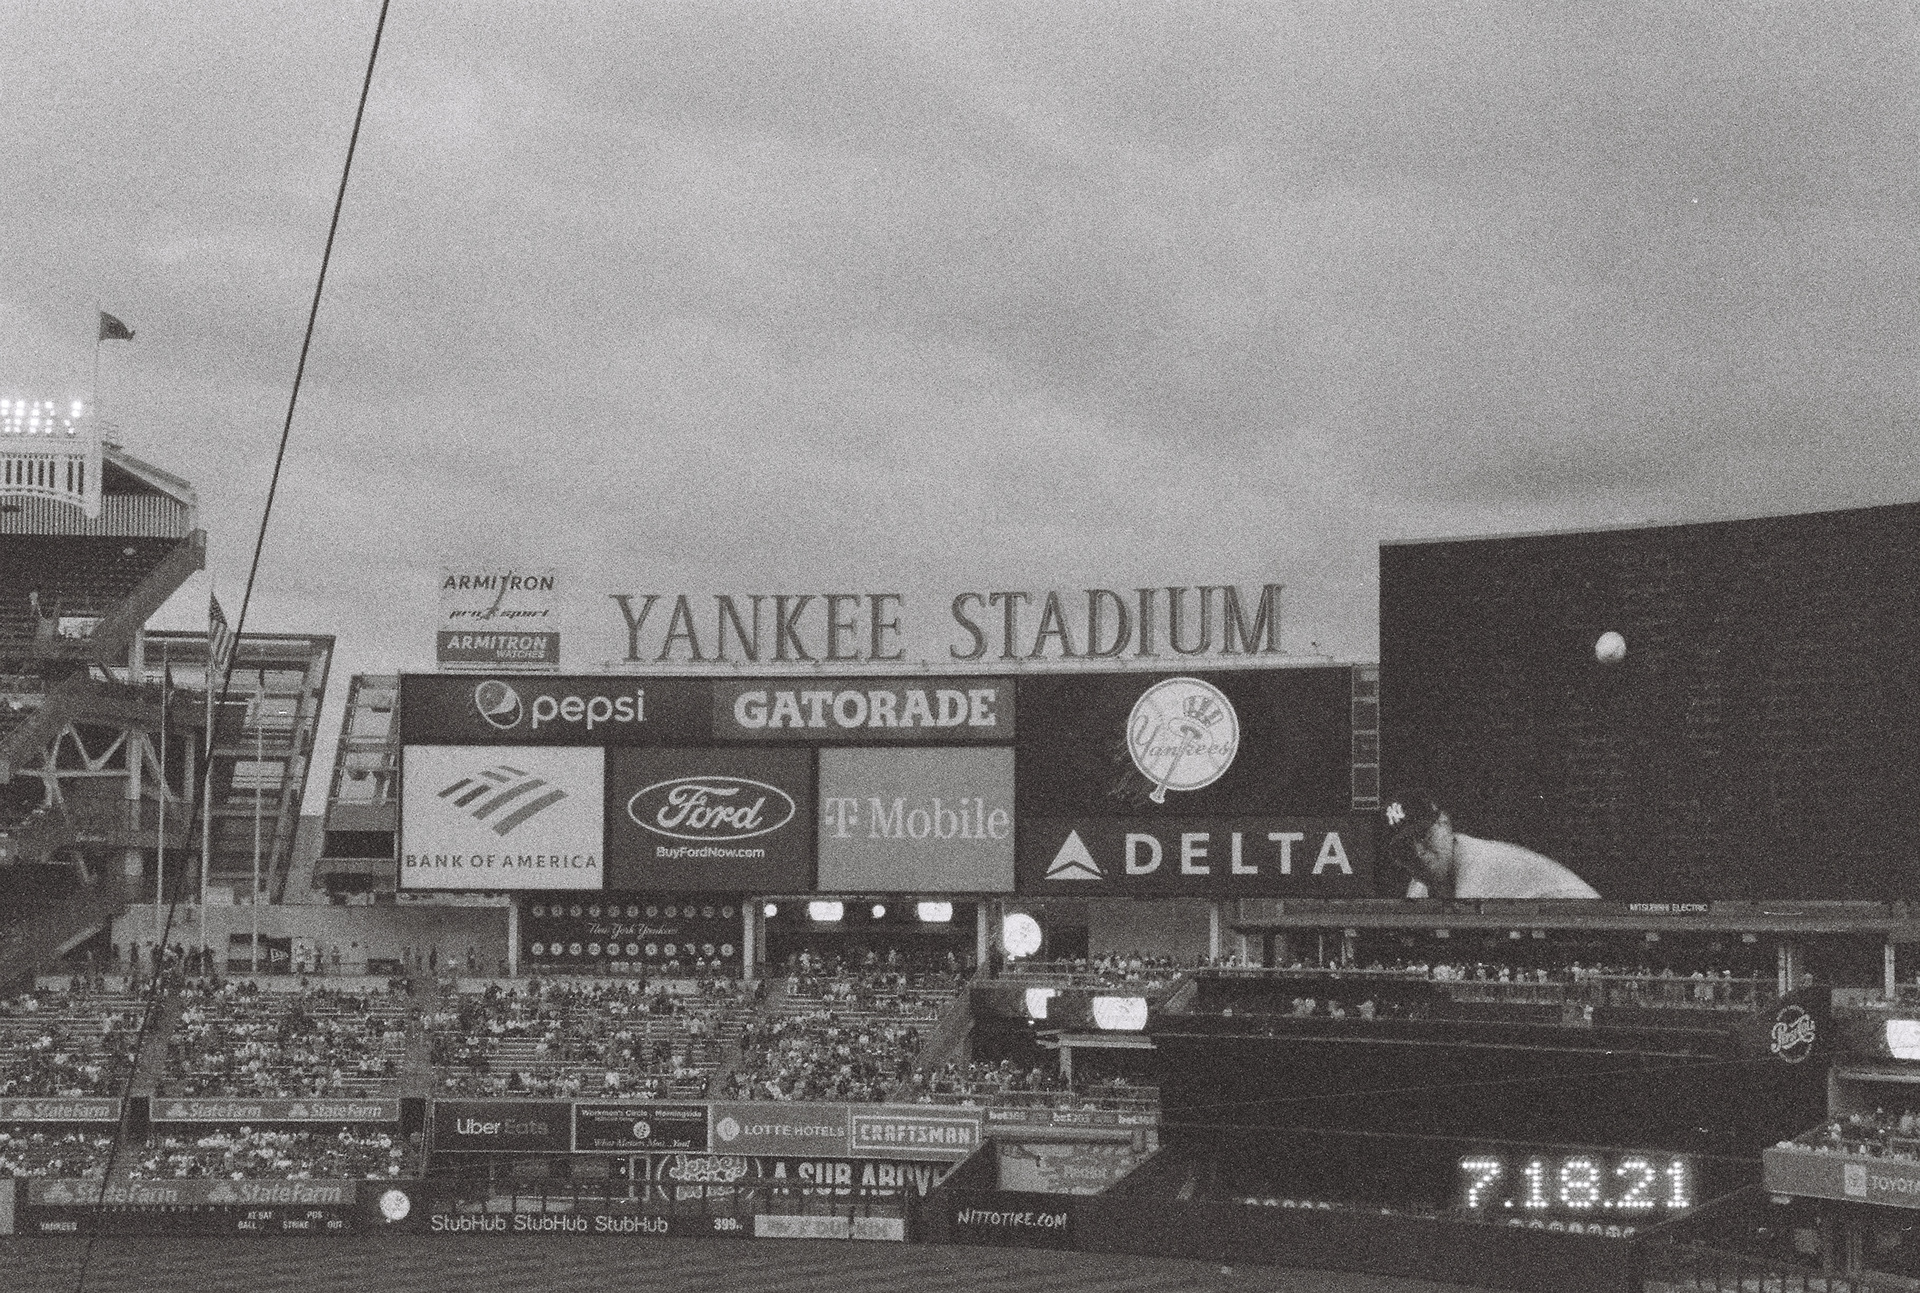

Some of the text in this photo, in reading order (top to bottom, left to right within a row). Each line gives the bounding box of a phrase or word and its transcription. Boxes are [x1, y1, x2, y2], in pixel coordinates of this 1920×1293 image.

[443, 574, 555, 590] ARMITRON
[609, 583, 1287, 665] YANKEE STADIUM
[447, 635, 547, 650] ARMITRON
[532, 689, 645, 729] pepsi
[733, 687, 998, 730] GATORADE
[657, 784, 764, 829] Ford
[867, 795, 1010, 841] Mobile
[405, 853, 598, 869] BANK OF AMERICA
[656, 846, 764, 859] BuyFordNow.com
[1124, 830, 1353, 874] DELTA
[457, 1118, 549, 1135] Uber Eats
[744, 1123, 846, 1138] LOTTE HOTELS
[860, 1124, 971, 1145] CRAFTSMAN
[773, 1162, 790, 1196] A
[798, 1162, 852, 1196] SUB
[431, 1214, 668, 1233] StubHub StubHub StubHub
[713, 1217, 737, 1231] 399
[957, 1208, 1068, 1230] NITTOTIRE.COM
